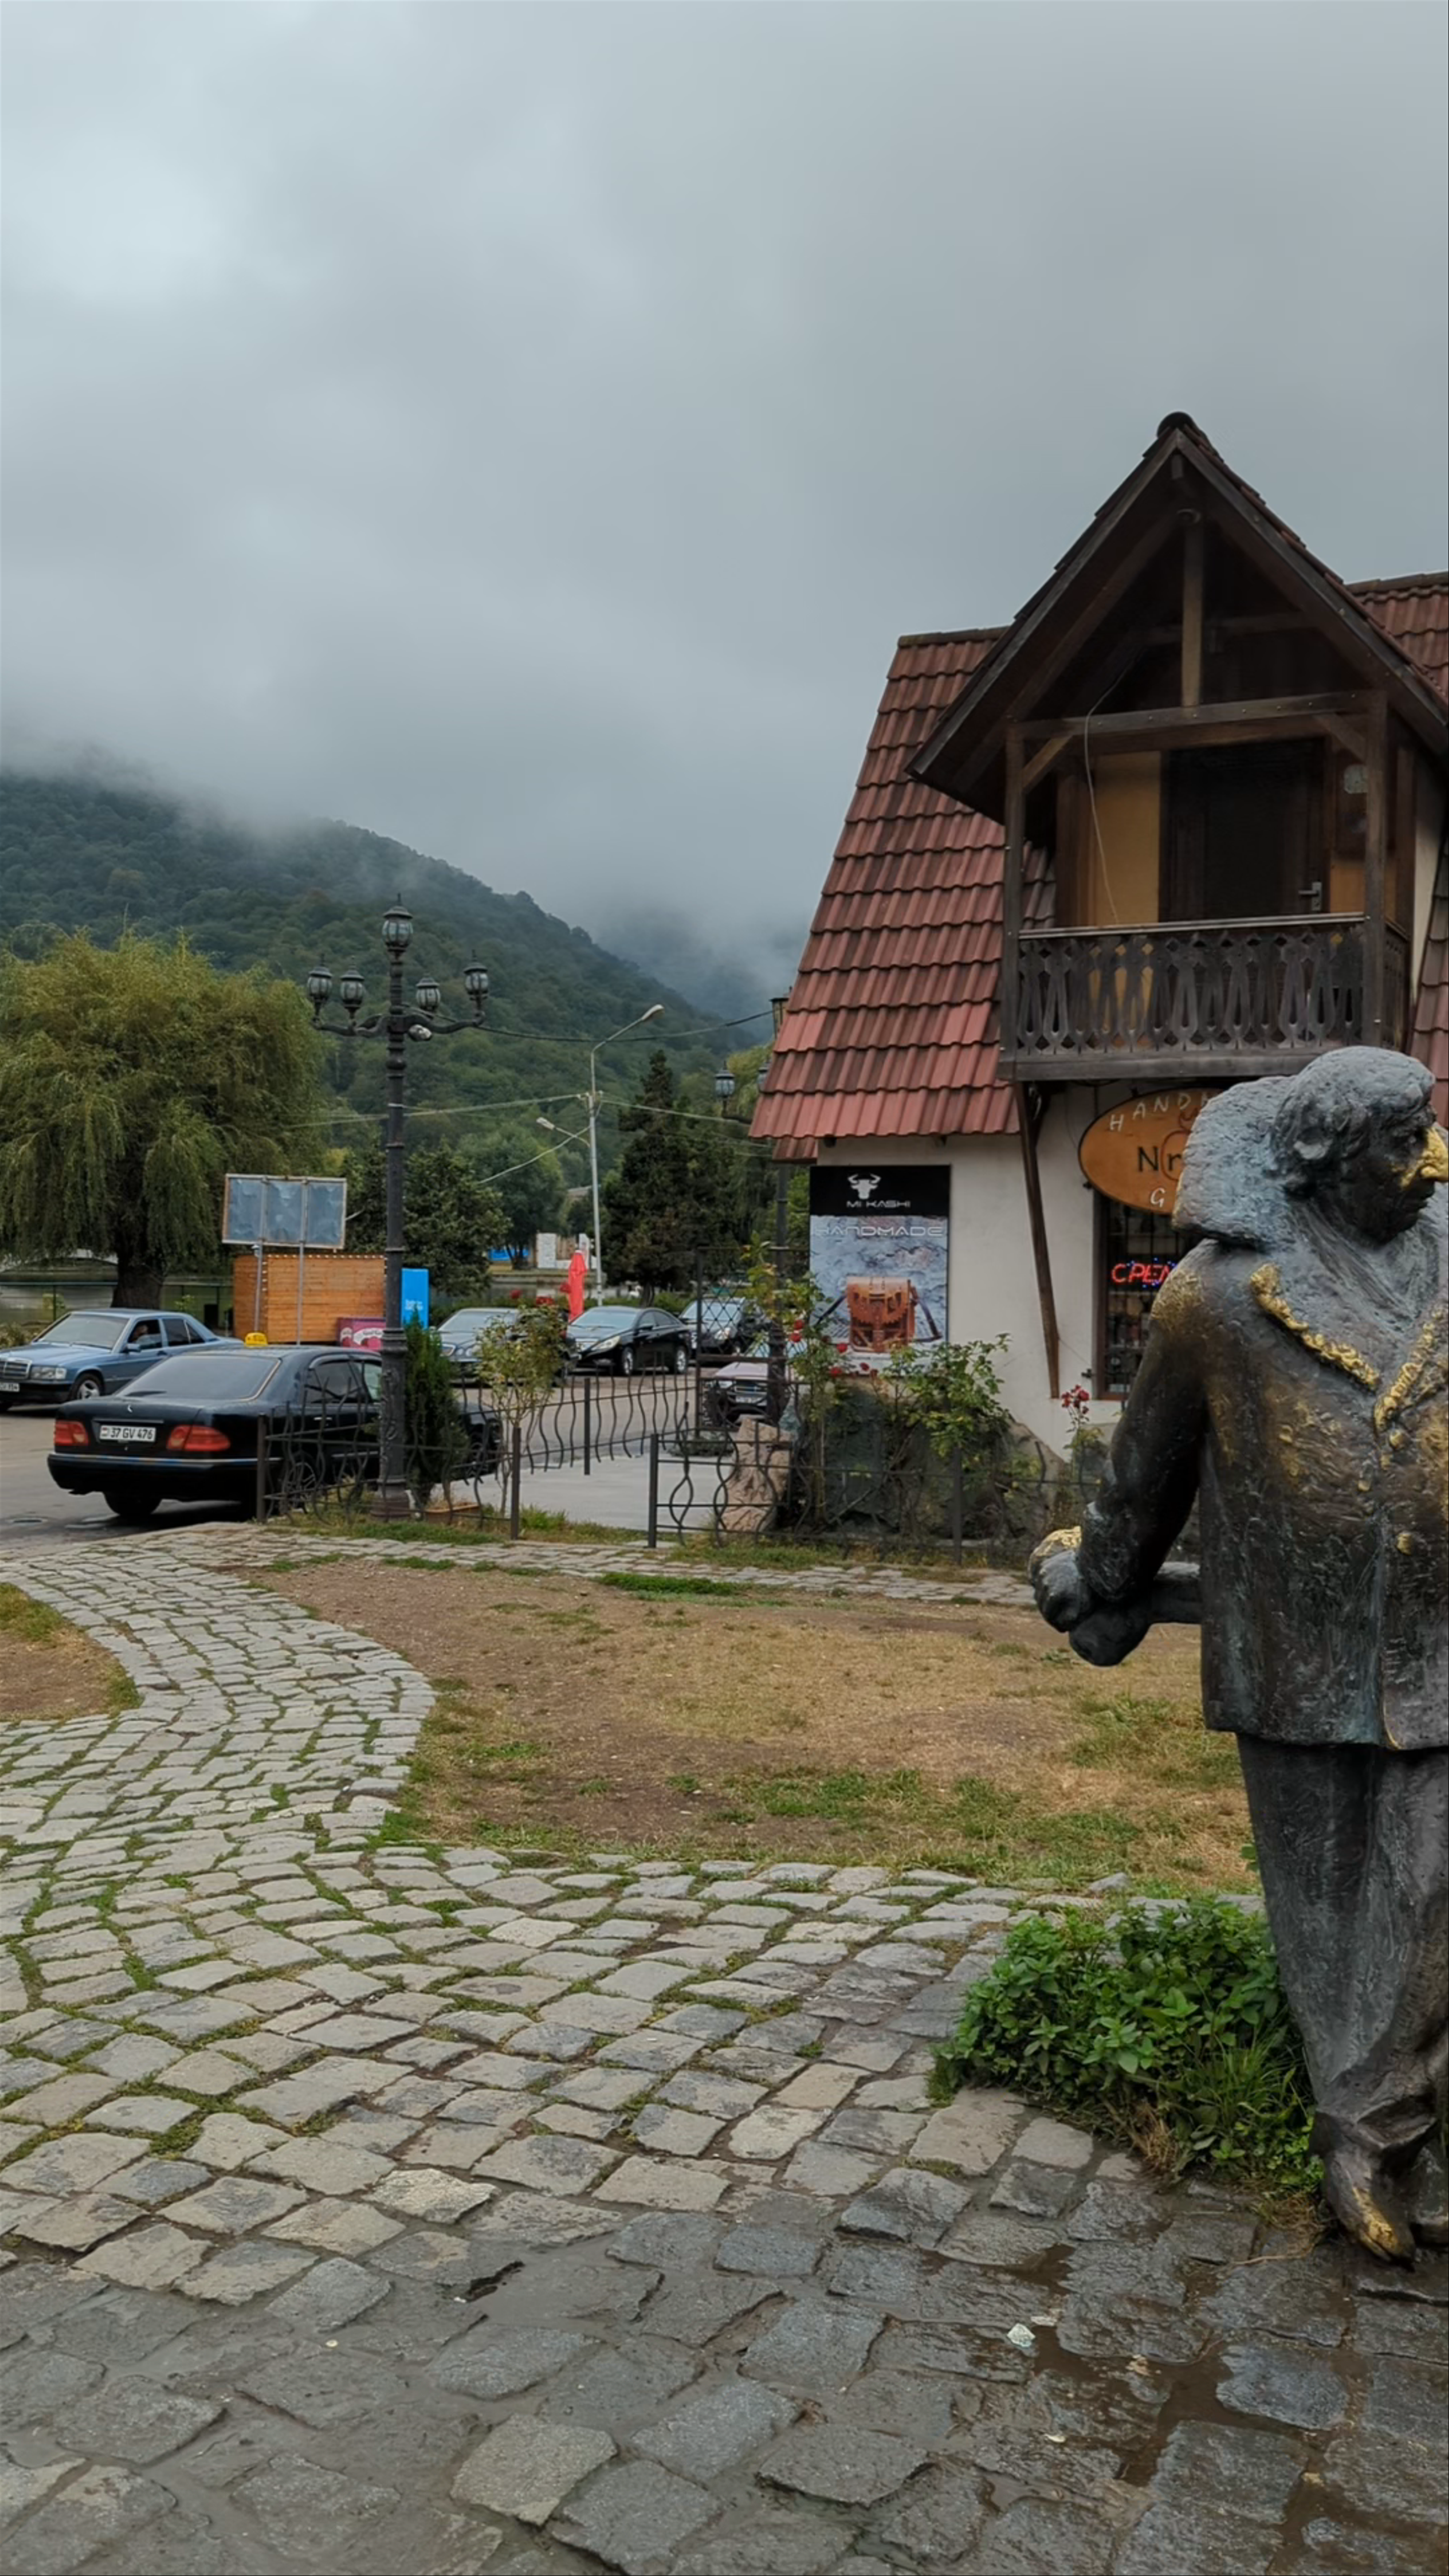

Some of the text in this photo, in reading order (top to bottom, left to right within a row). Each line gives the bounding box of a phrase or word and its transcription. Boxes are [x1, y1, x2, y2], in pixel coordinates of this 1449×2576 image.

[814, 1226, 943, 1236] HANDMADE
[111, 1427, 153, 1439] 37 GV 476
